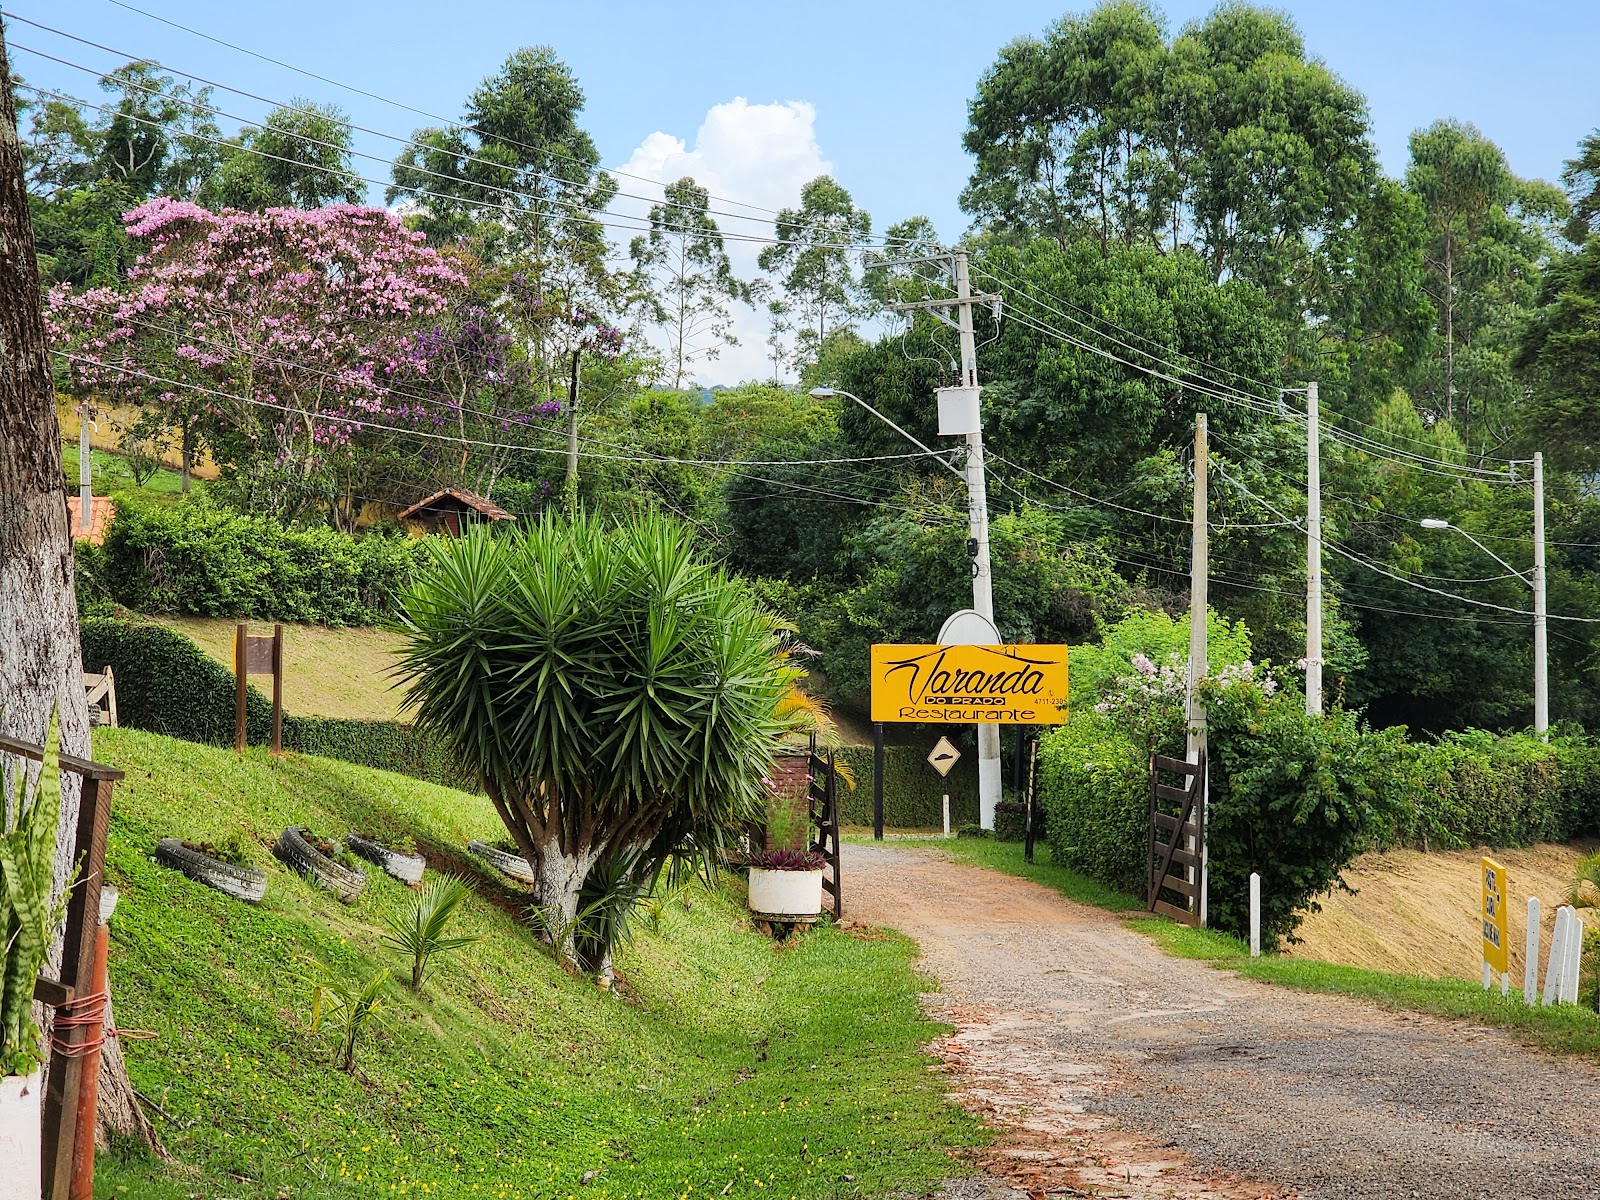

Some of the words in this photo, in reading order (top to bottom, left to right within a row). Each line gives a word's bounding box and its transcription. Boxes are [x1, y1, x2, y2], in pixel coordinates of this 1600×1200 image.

[884, 652, 1044, 705] Varanda
[925, 697, 946, 705] DO
[952, 697, 1005, 705] PRADO
[899, 707, 1036, 721] Restaurante
